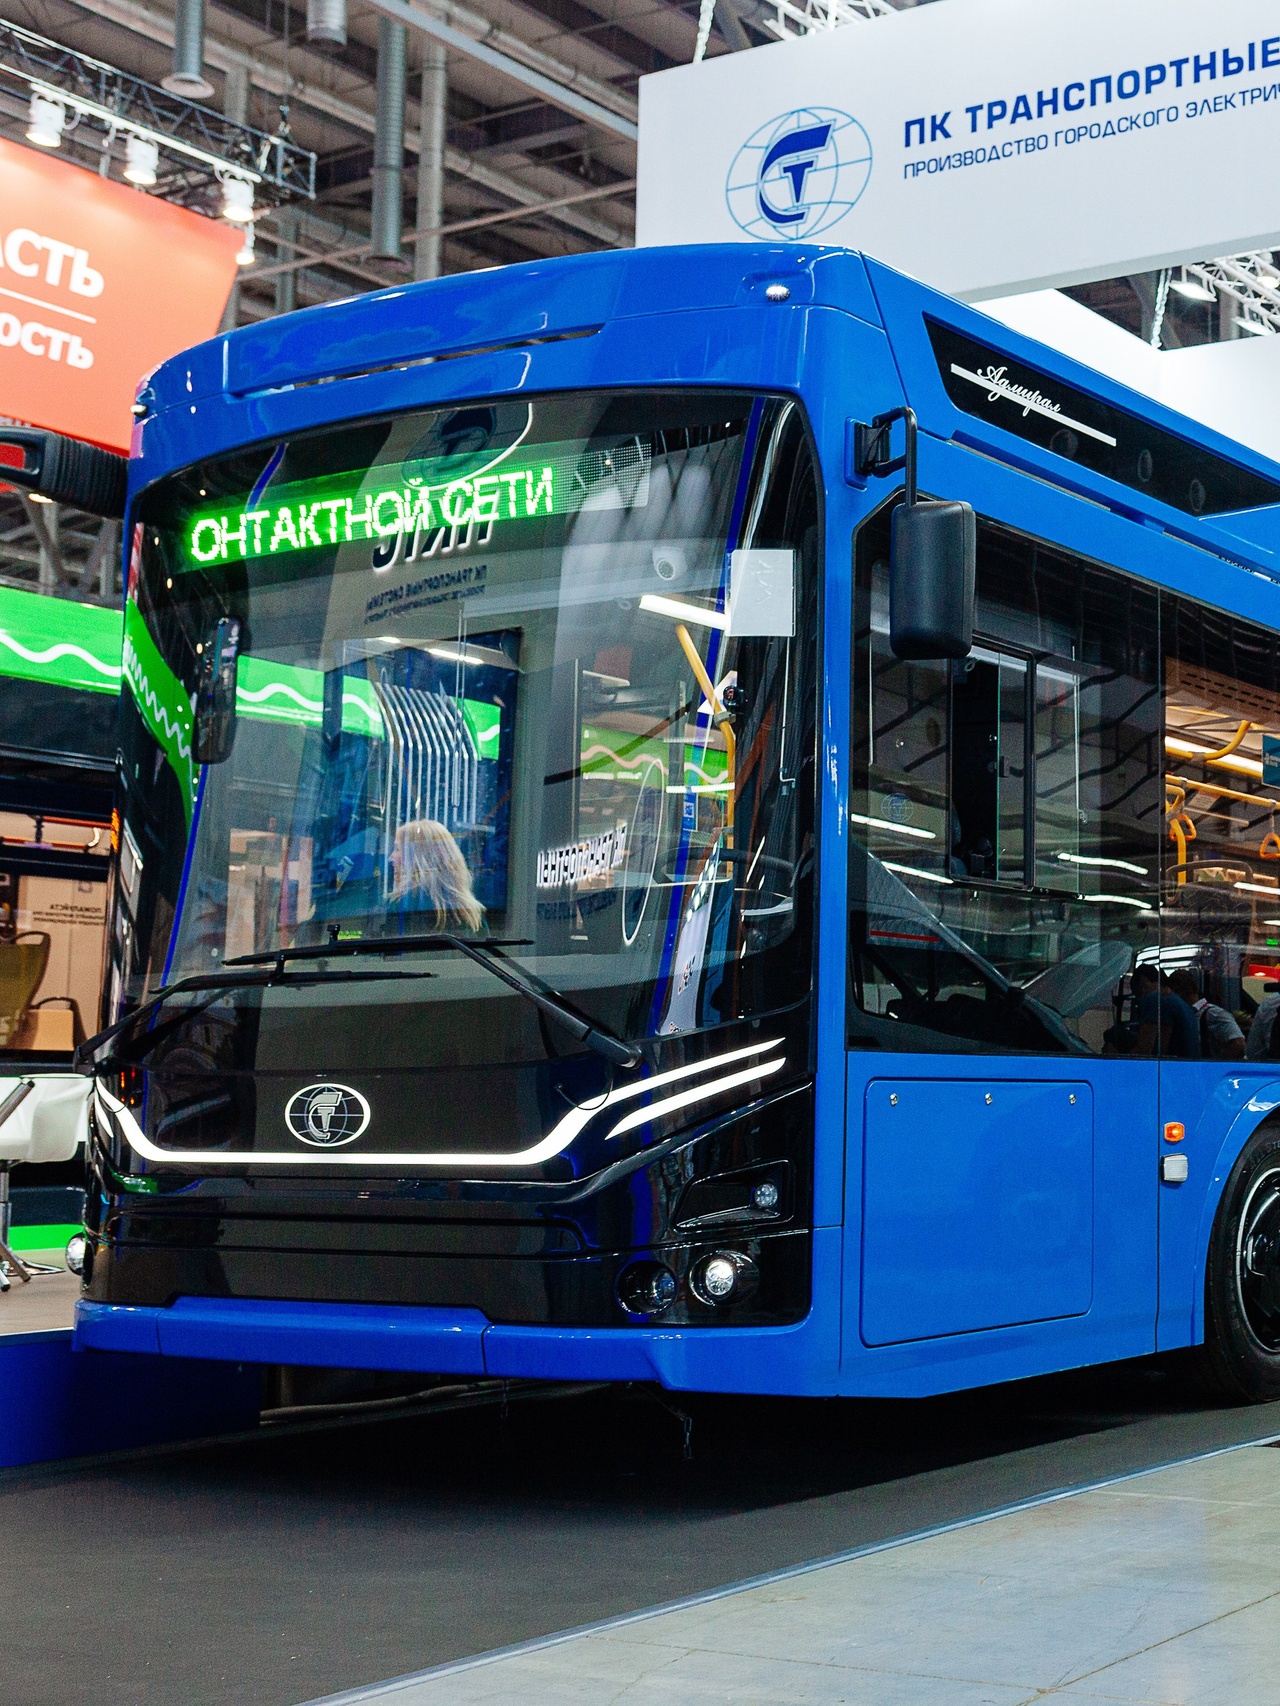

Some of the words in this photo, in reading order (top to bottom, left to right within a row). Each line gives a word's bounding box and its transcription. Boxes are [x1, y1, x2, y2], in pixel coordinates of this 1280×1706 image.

[904, 111, 952, 148] ПК
[965, 37, 1280, 133] ТРАНСПОРТНЫЕ
[904, 134, 1048, 179] ПРОИЗВОДСТВО
[1054, 105, 1179, 147] ГОРОДСКОГО
[0, 228, 104, 298] СТЬ
[977, 365, 1061, 417] Адмирал
[191, 477, 430, 562] ОНТАКТНОЙ
[442, 467, 554, 526] СЕТИ
